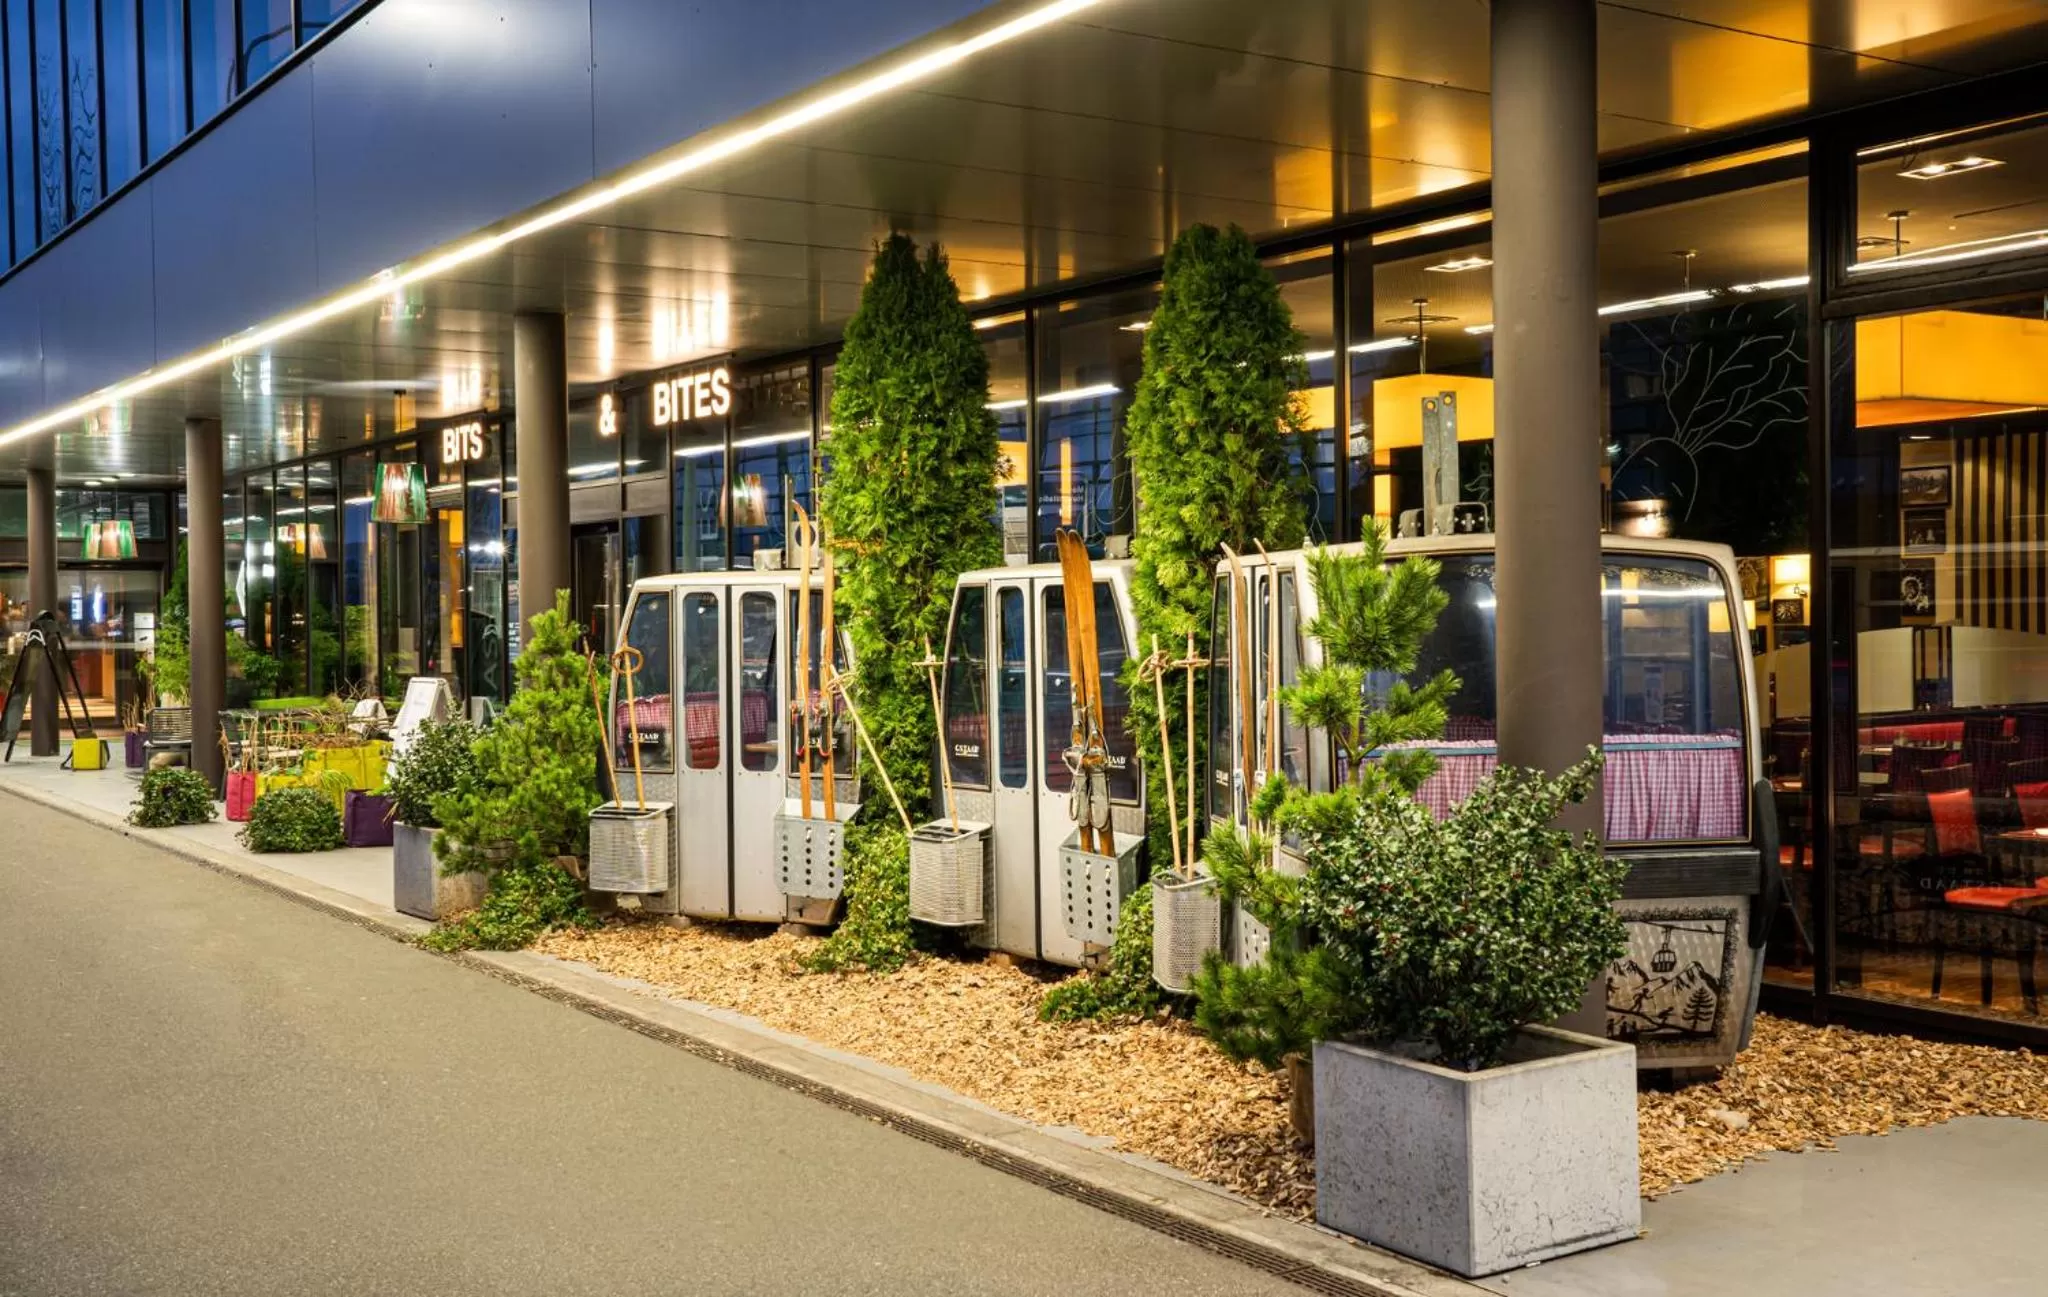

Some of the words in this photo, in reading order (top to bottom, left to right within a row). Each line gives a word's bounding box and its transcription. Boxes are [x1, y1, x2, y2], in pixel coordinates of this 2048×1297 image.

[443, 421, 483, 464] BITS
[599, 393, 617, 436] &
[653, 367, 731, 426] BITES
